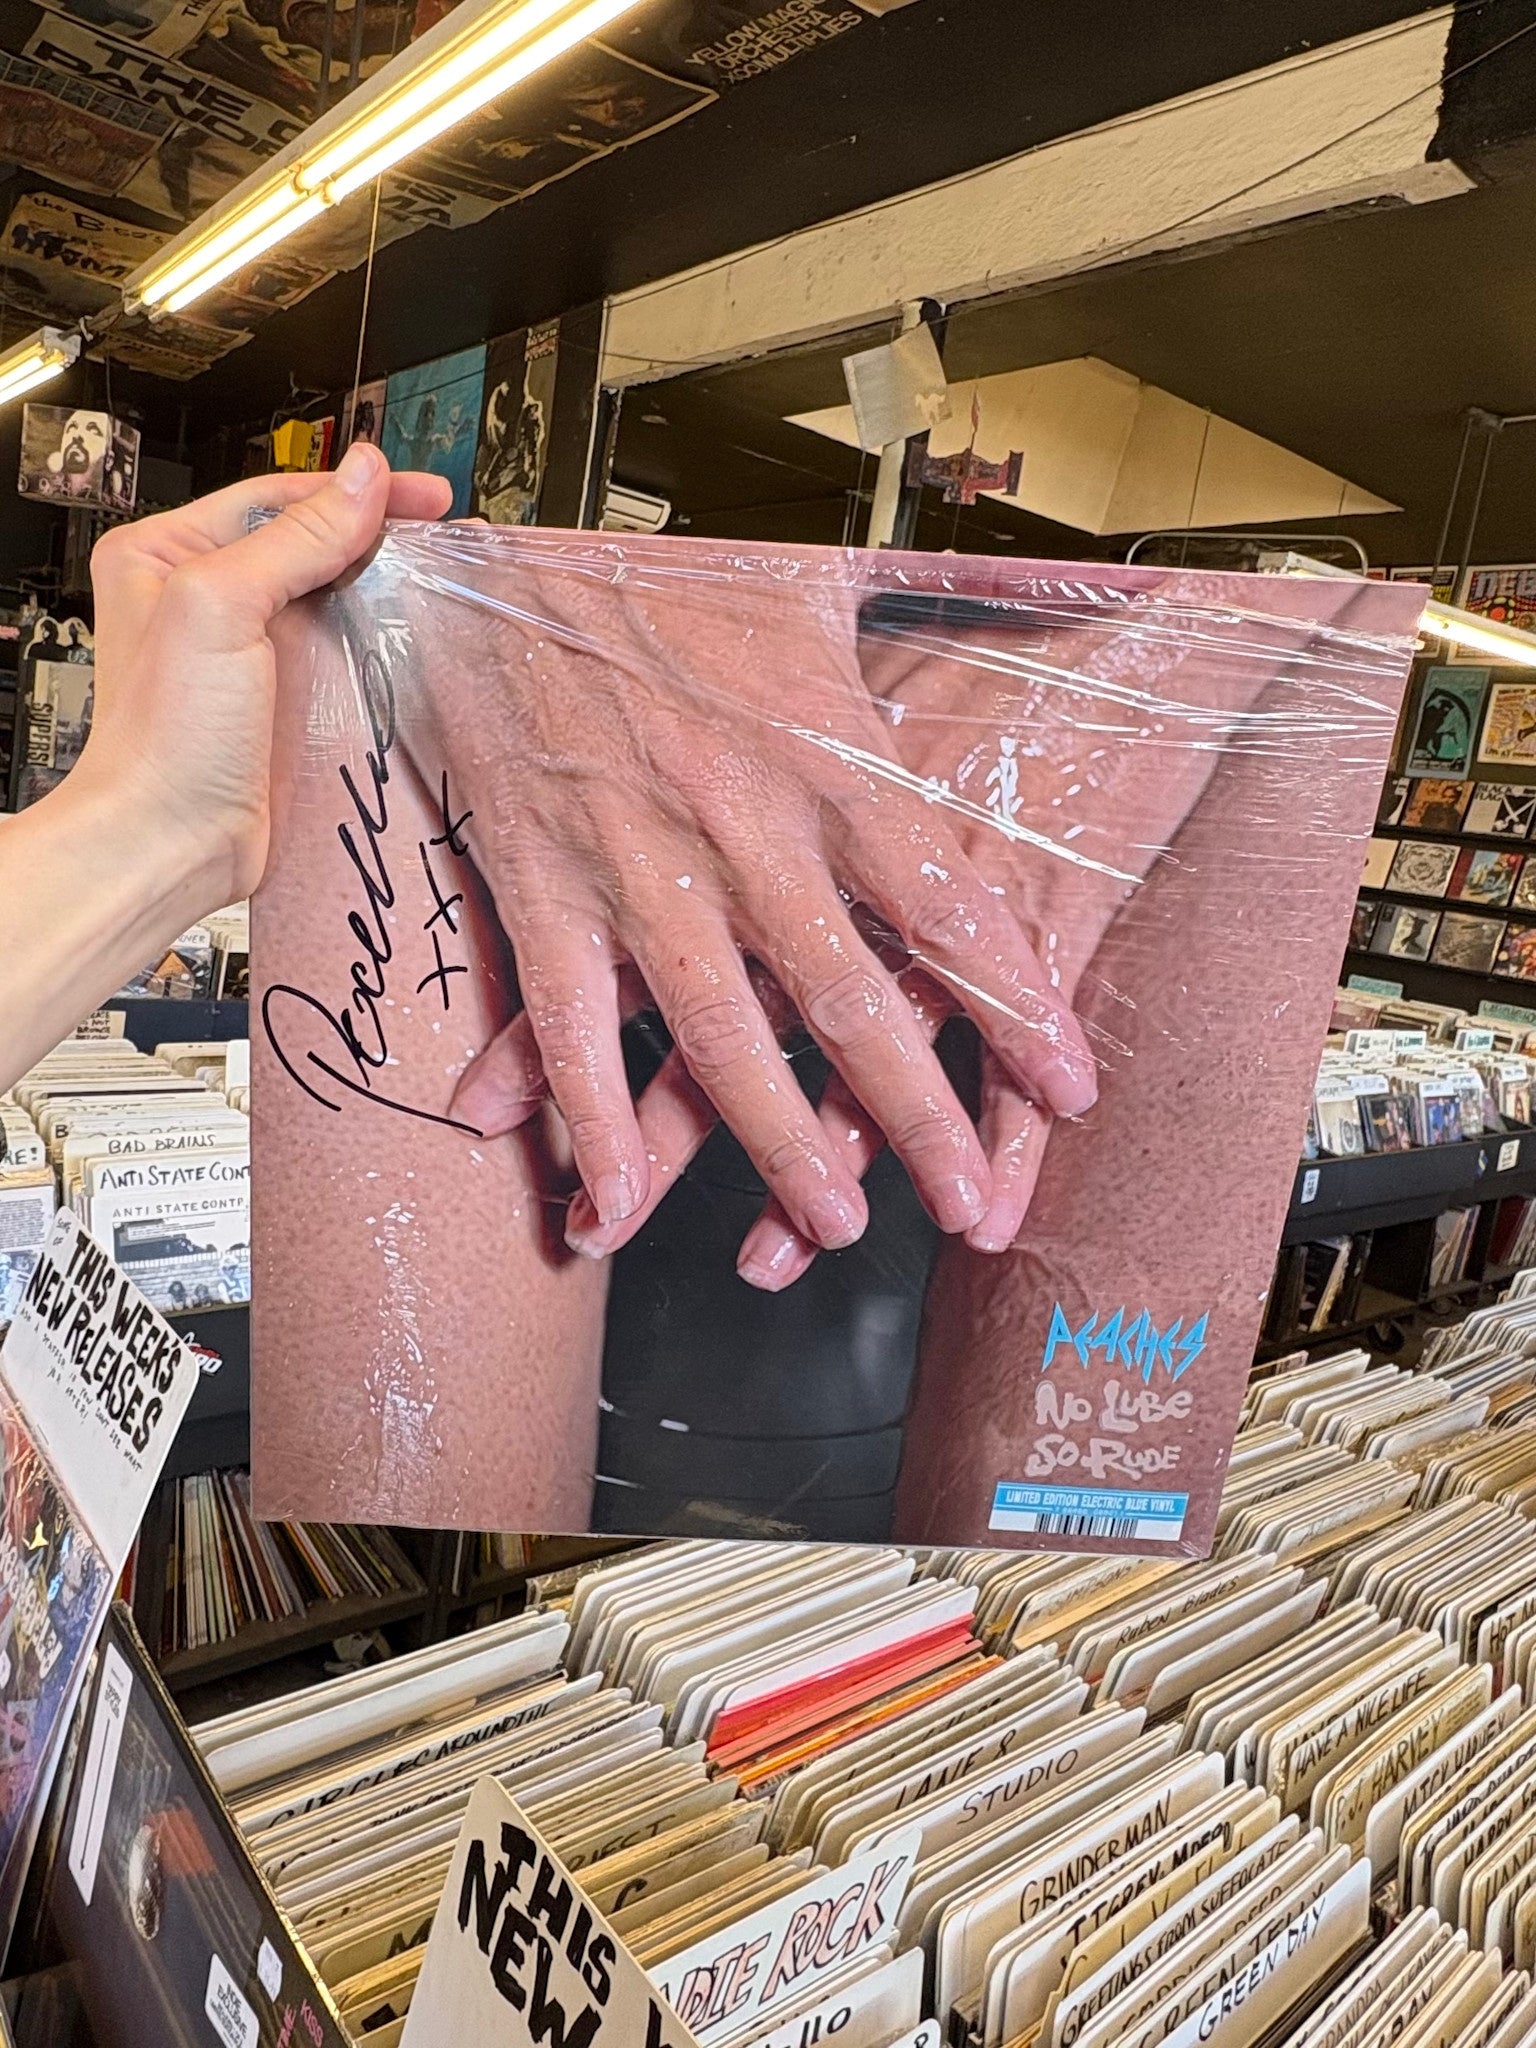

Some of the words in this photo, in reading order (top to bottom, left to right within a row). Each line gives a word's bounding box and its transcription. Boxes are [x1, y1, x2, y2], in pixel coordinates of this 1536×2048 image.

[685, 20, 763, 66] YELLOW
[757, 0, 826, 28] MAGI
[715, 9, 832, 70] ORCHESTRA
[95, 39, 254, 121] THE
[66, 649, 89, 665] U2
[100, 1167, 144, 1190] ANTI
[147, 1164, 205, 1186] STATE
[108, 1139, 146, 1154] BAD
[155, 1134, 216, 1150] BRAINS
[112, 1206, 150, 1218] ANTI
[156, 1202, 199, 1214] STATE
[65, 1230, 116, 1314] THIS
[26, 1252, 77, 1331] NEW
[64, 1302, 164, 1454] RELEASES
[1042, 1300, 1210, 1385] PEACHES
[1035, 1380, 1092, 1430] No
[1023, 1433, 1080, 1477] So
[1005, 1489, 1041, 1505] LIMITED
[1042, 1491, 1079, 1507] EDITION
[1080, 1494, 1123, 1510] ELECTRIC
[1125, 1497, 1149, 1511] BLUE
[1150, 1499, 1175, 1513] VINYL
[1293, 1734, 1334, 1784] HAVE
[1335, 1723, 1348, 1742] A
[1354, 1690, 1391, 1737] NICE
[1391, 1667, 1435, 1712] LIFE
[955, 1748, 1080, 1826] STUDIO
[1019, 1789, 1172, 1927] GRINDERMAN
[457, 1839, 603, 2048] NEW
[499, 1821, 618, 2007] THIS
[662, 1931, 773, 2036] DIE
[757, 1855, 909, 2006] ROCK
[1060, 1946, 1153, 2048] GREETINGS
[1157, 1908, 1197, 1959] FROM
[1201, 1838, 1290, 1918] SUFFOCATE
[1198, 1941, 1279, 2042] GREEN
[1286, 1898, 1326, 1959] DAY
